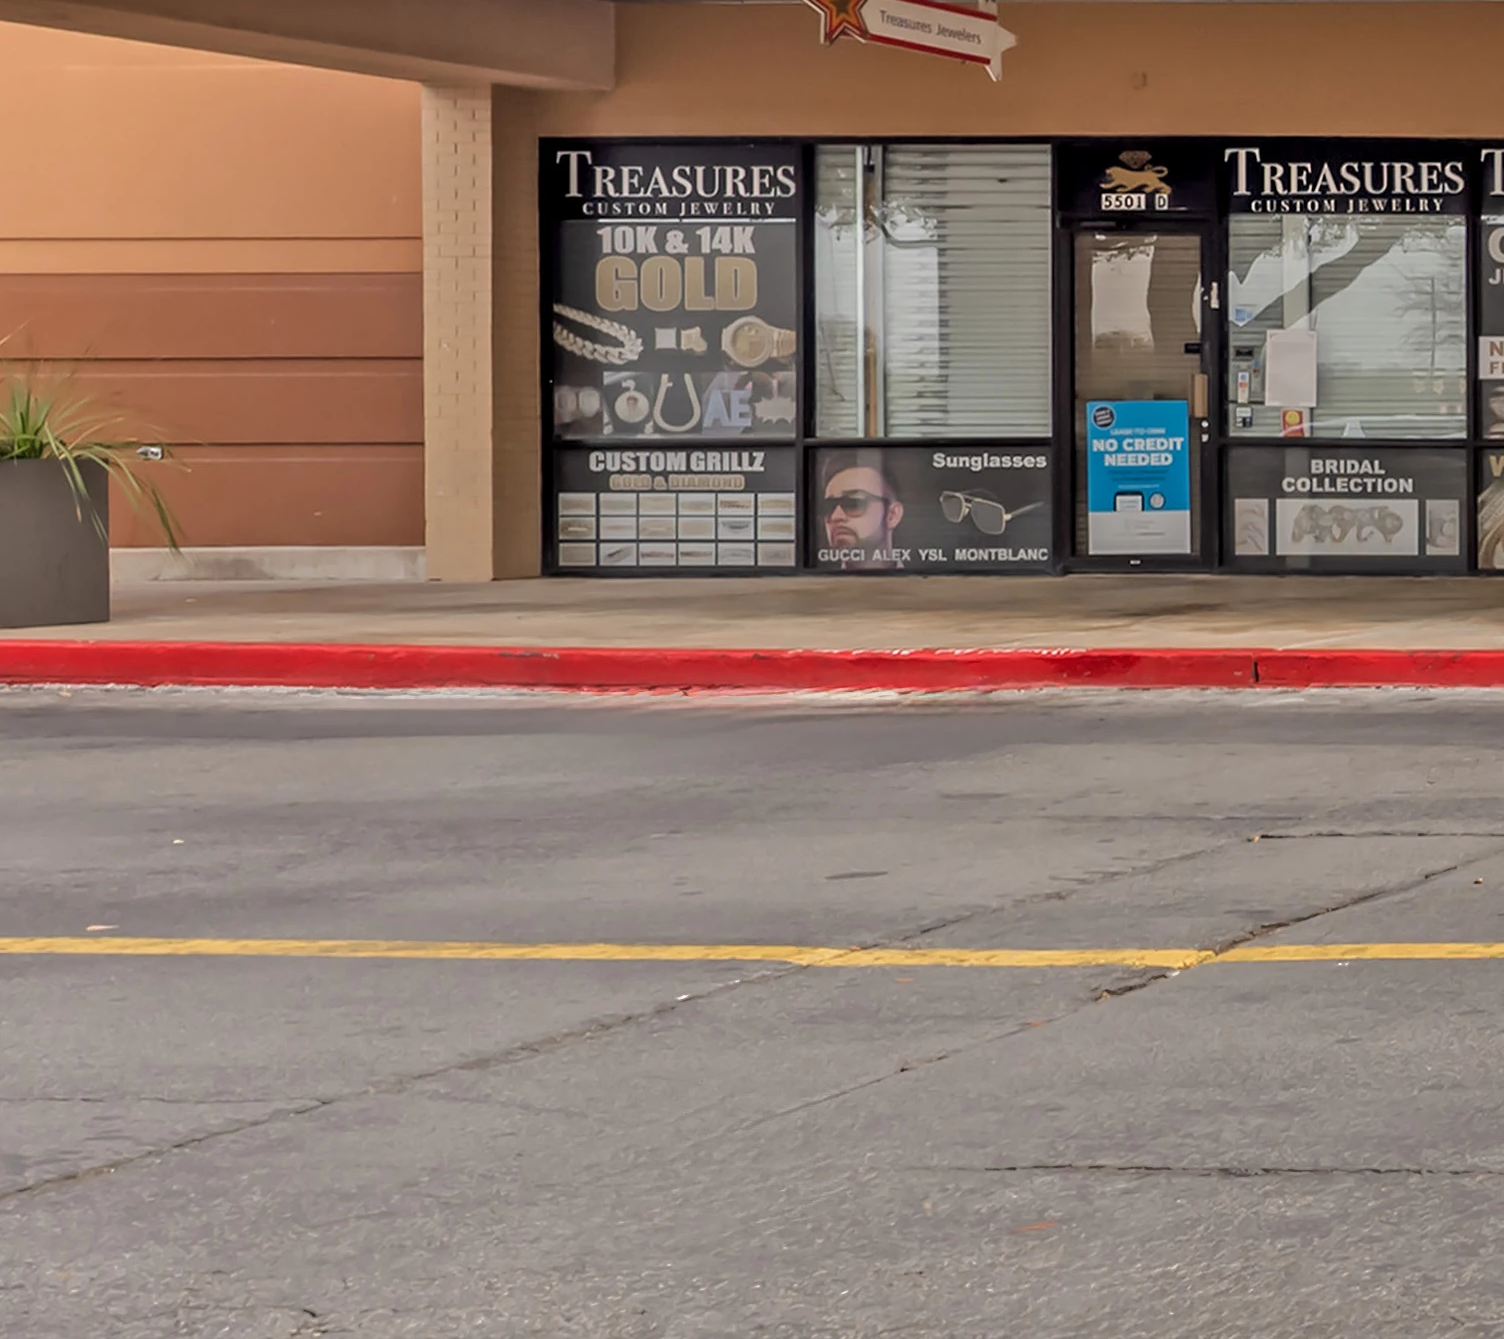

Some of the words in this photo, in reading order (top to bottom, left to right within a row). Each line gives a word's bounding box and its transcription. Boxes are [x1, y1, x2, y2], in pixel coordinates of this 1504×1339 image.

[879, 10, 932, 34] Treasures
[937, 23, 981, 44] Jewelers
[556, 150, 796, 198] TREASURES
[1224, 148, 1465, 196] TREASURES
[582, 202, 668, 216] CUSTOM
[679, 202, 776, 216] JEWELRY
[1103, 195, 1143, 209] 5501
[1251, 199, 1336, 213] CUSTOM
[1347, 199, 1444, 213] JEWELRY
[597, 226, 658, 254] 10K
[665, 230, 689, 254] &
[696, 226, 756, 254] 14K
[595, 255, 758, 312] GOLD
[1092, 438, 1118, 452] NO
[1122, 437, 1184, 452] CREDIT
[589, 451, 686, 472] CUSTOM
[690, 451, 765, 472] GRILLZ
[932, 453, 1047, 471] Sunglasses
[1104, 453, 1173, 467] NEEDED
[1310, 459, 1386, 474] BRIDAL
[1282, 477, 1413, 493] COLLECTION
[818, 549, 865, 562] GUCCI
[872, 549, 911, 562] ALEX
[918, 549, 947, 562] YSL
[955, 548, 1048, 562] MONTBLANC
